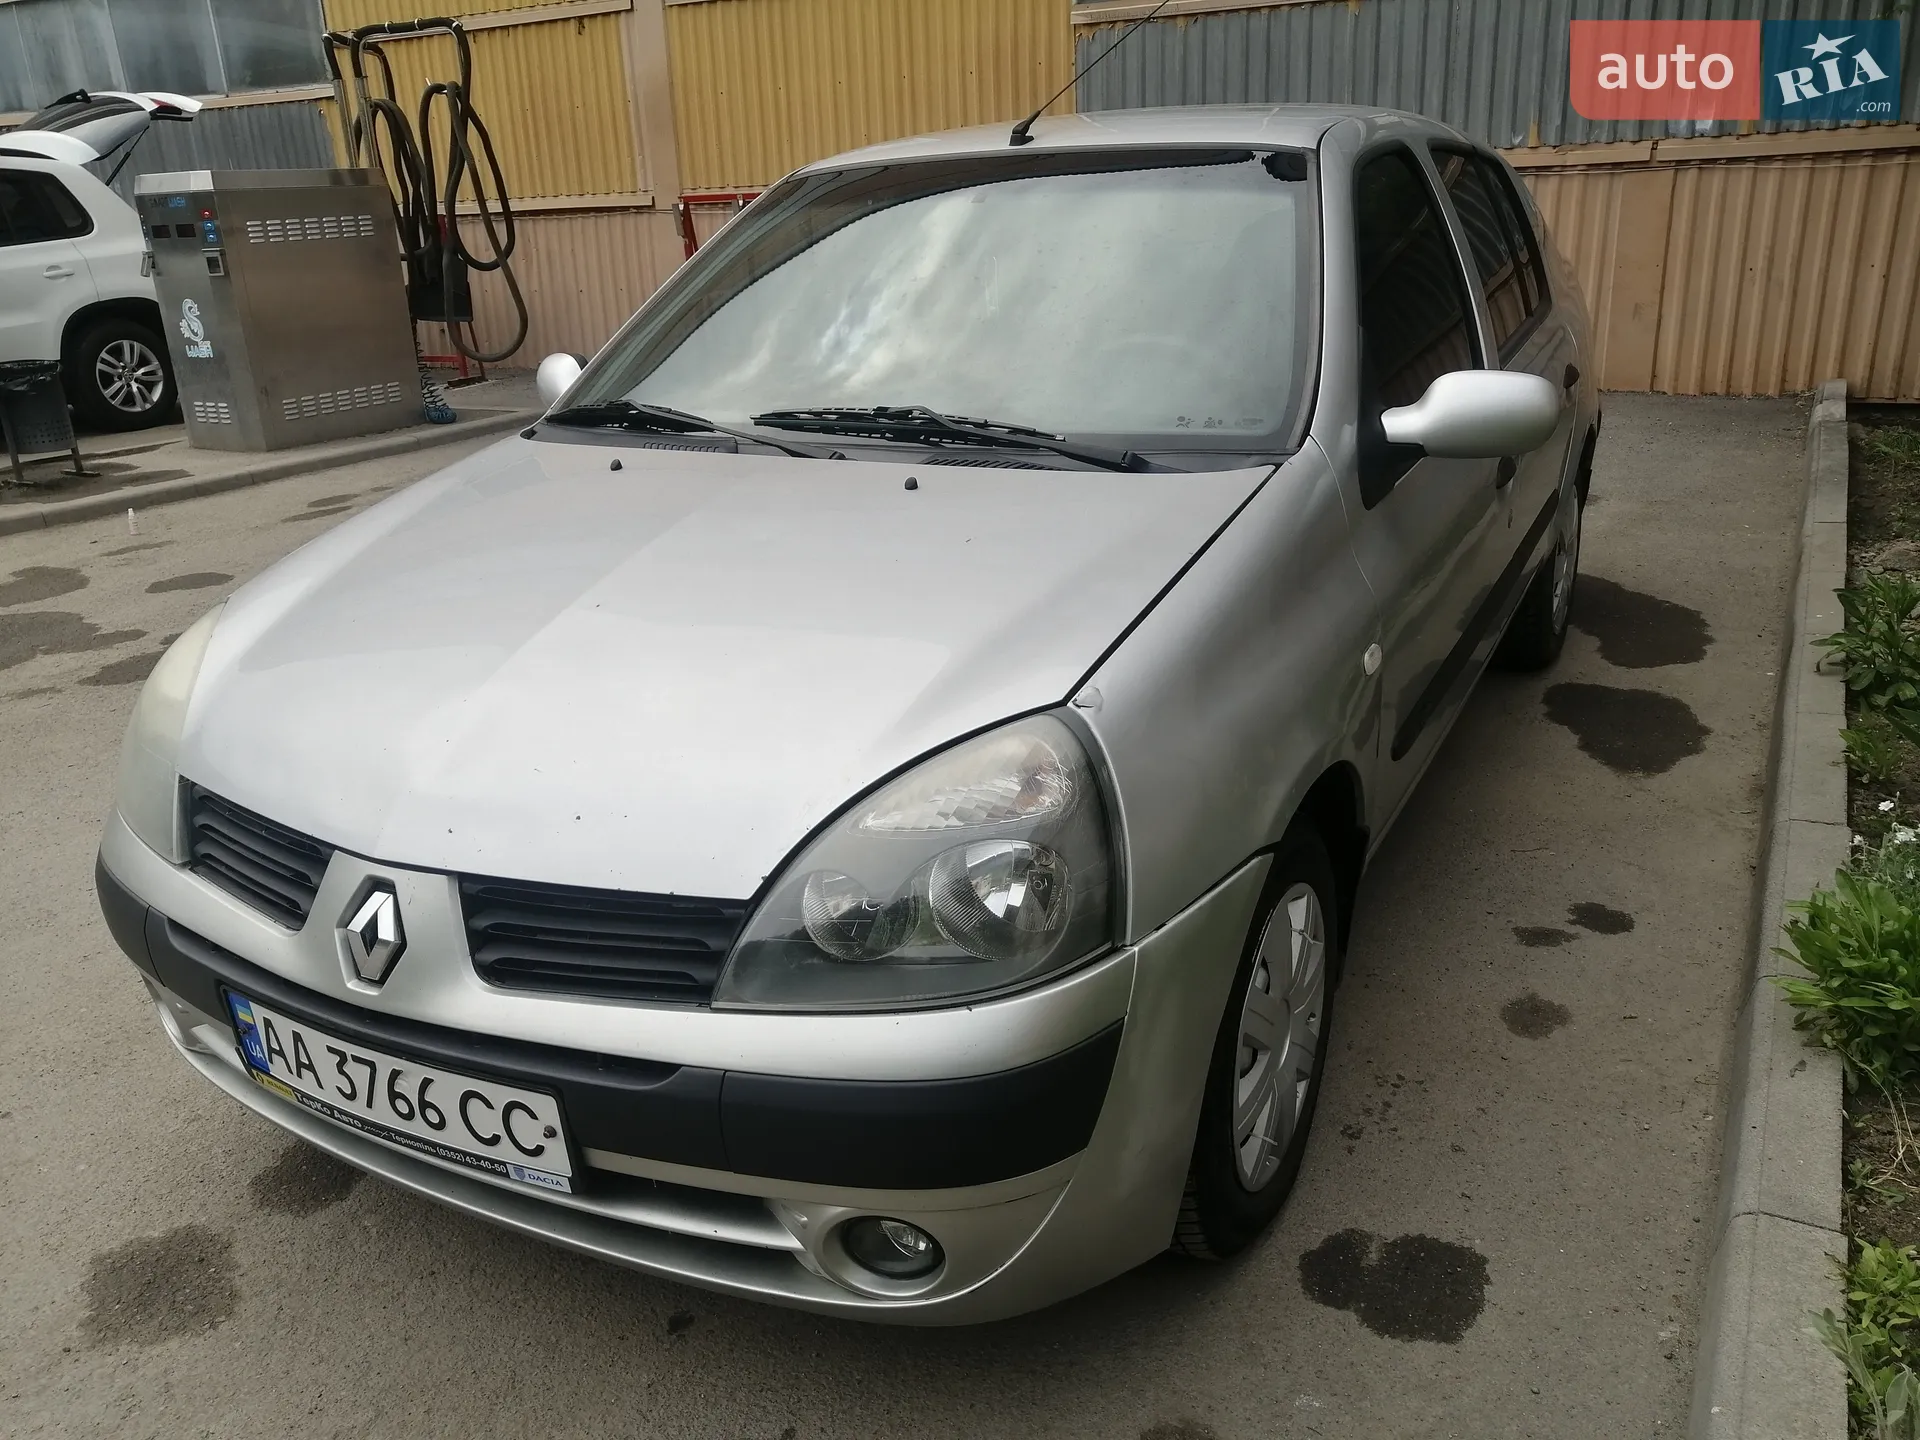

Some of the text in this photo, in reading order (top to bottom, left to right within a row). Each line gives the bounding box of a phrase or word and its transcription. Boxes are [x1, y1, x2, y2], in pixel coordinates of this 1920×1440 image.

[246, 1038, 265, 1062] UA
[262, 1015, 546, 1158] AA 3766 CC
[389, 1131, 436, 1153] Тернопіль
[436, 1146, 465, 1163] (0352)
[465, 1156, 507, 1174] 43-40-50
[527, 1173, 564, 1188] DACIA
